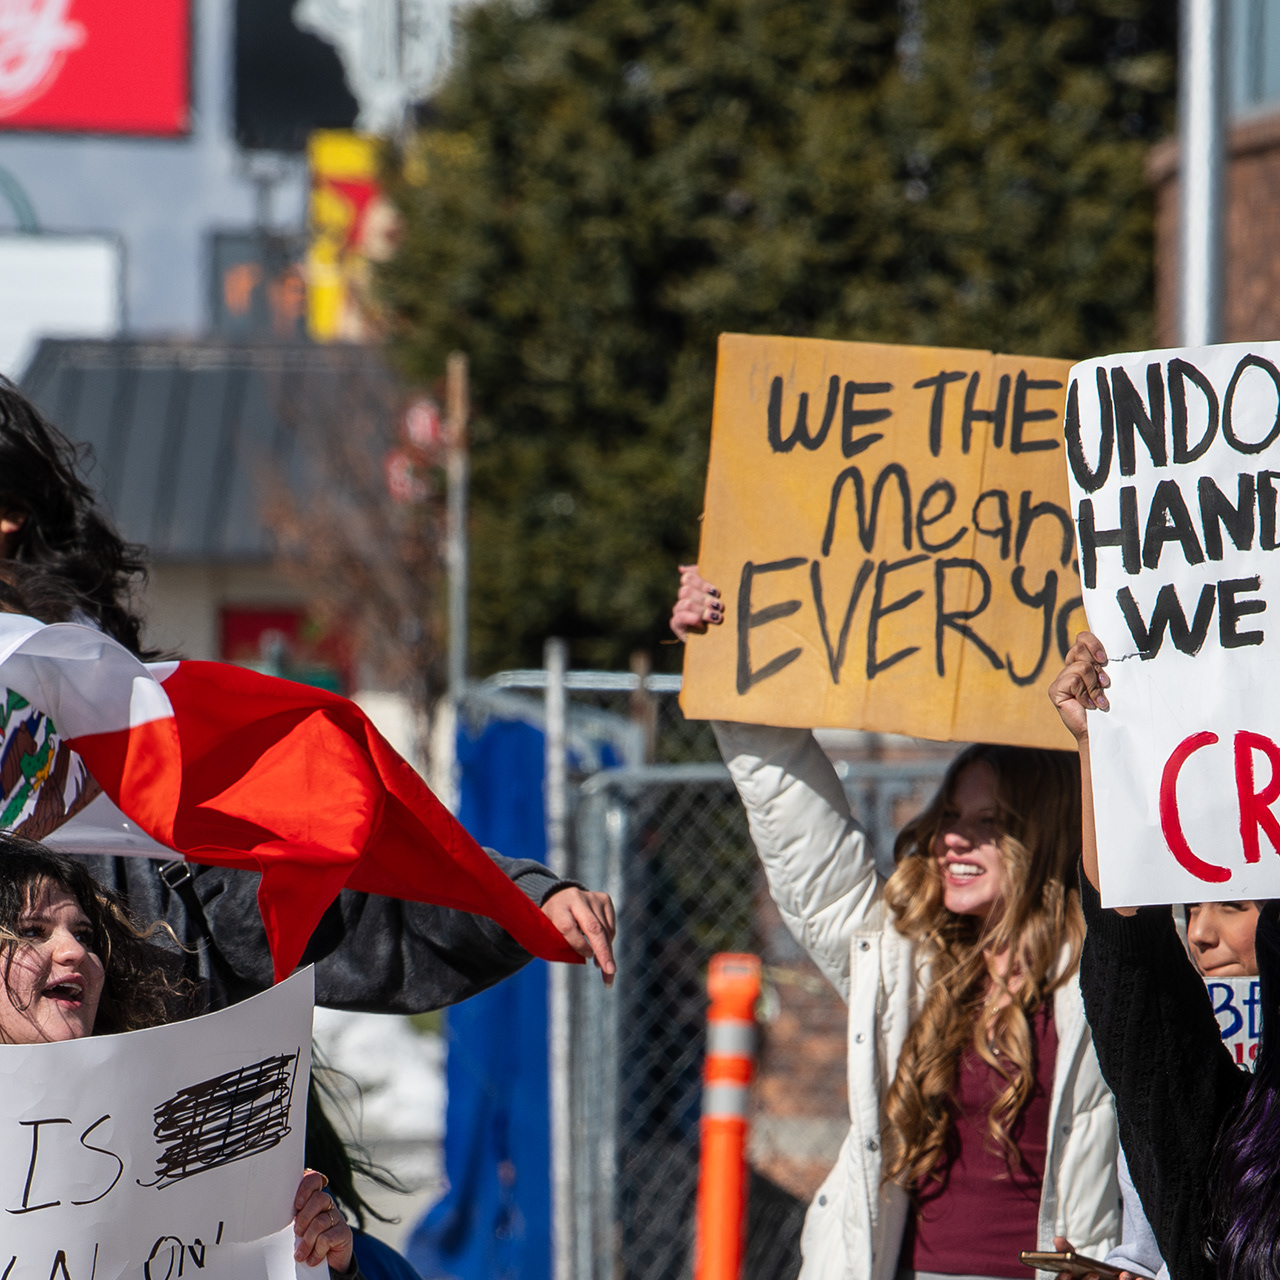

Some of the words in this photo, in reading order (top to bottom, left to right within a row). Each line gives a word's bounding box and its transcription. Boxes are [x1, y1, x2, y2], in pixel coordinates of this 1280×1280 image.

[767, 374, 893, 458] WE
[913, 370, 1064, 457] THE
[821, 462, 1080, 567] Mean
[1117, 575, 1266, 661] WE
[5, 1114, 124, 1215] IS
